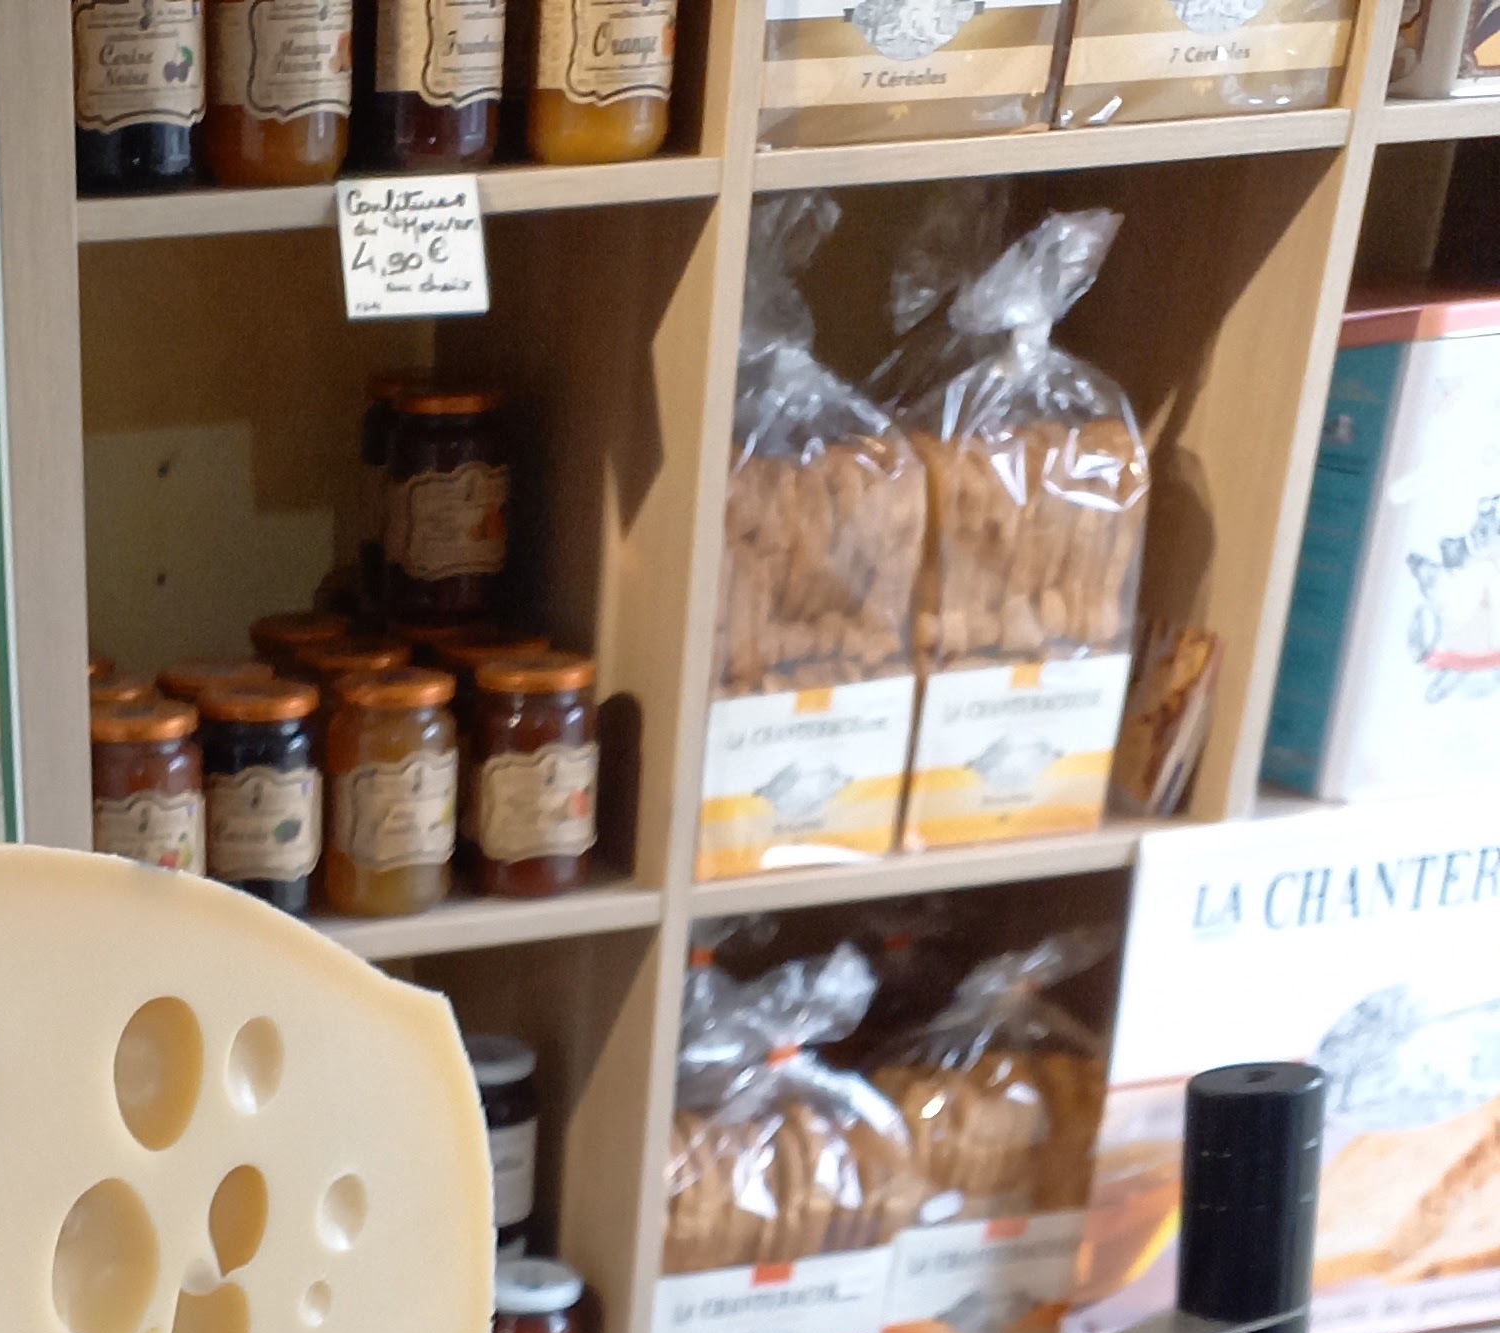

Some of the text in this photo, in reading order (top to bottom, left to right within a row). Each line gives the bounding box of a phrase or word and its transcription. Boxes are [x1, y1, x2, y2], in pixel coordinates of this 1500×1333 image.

[592, 21, 658, 64] Orange
[1169, 47, 1180, 64] 7
[861, 67, 947, 89] 7 Céréales
[1193, 882, 1242, 930] LA
